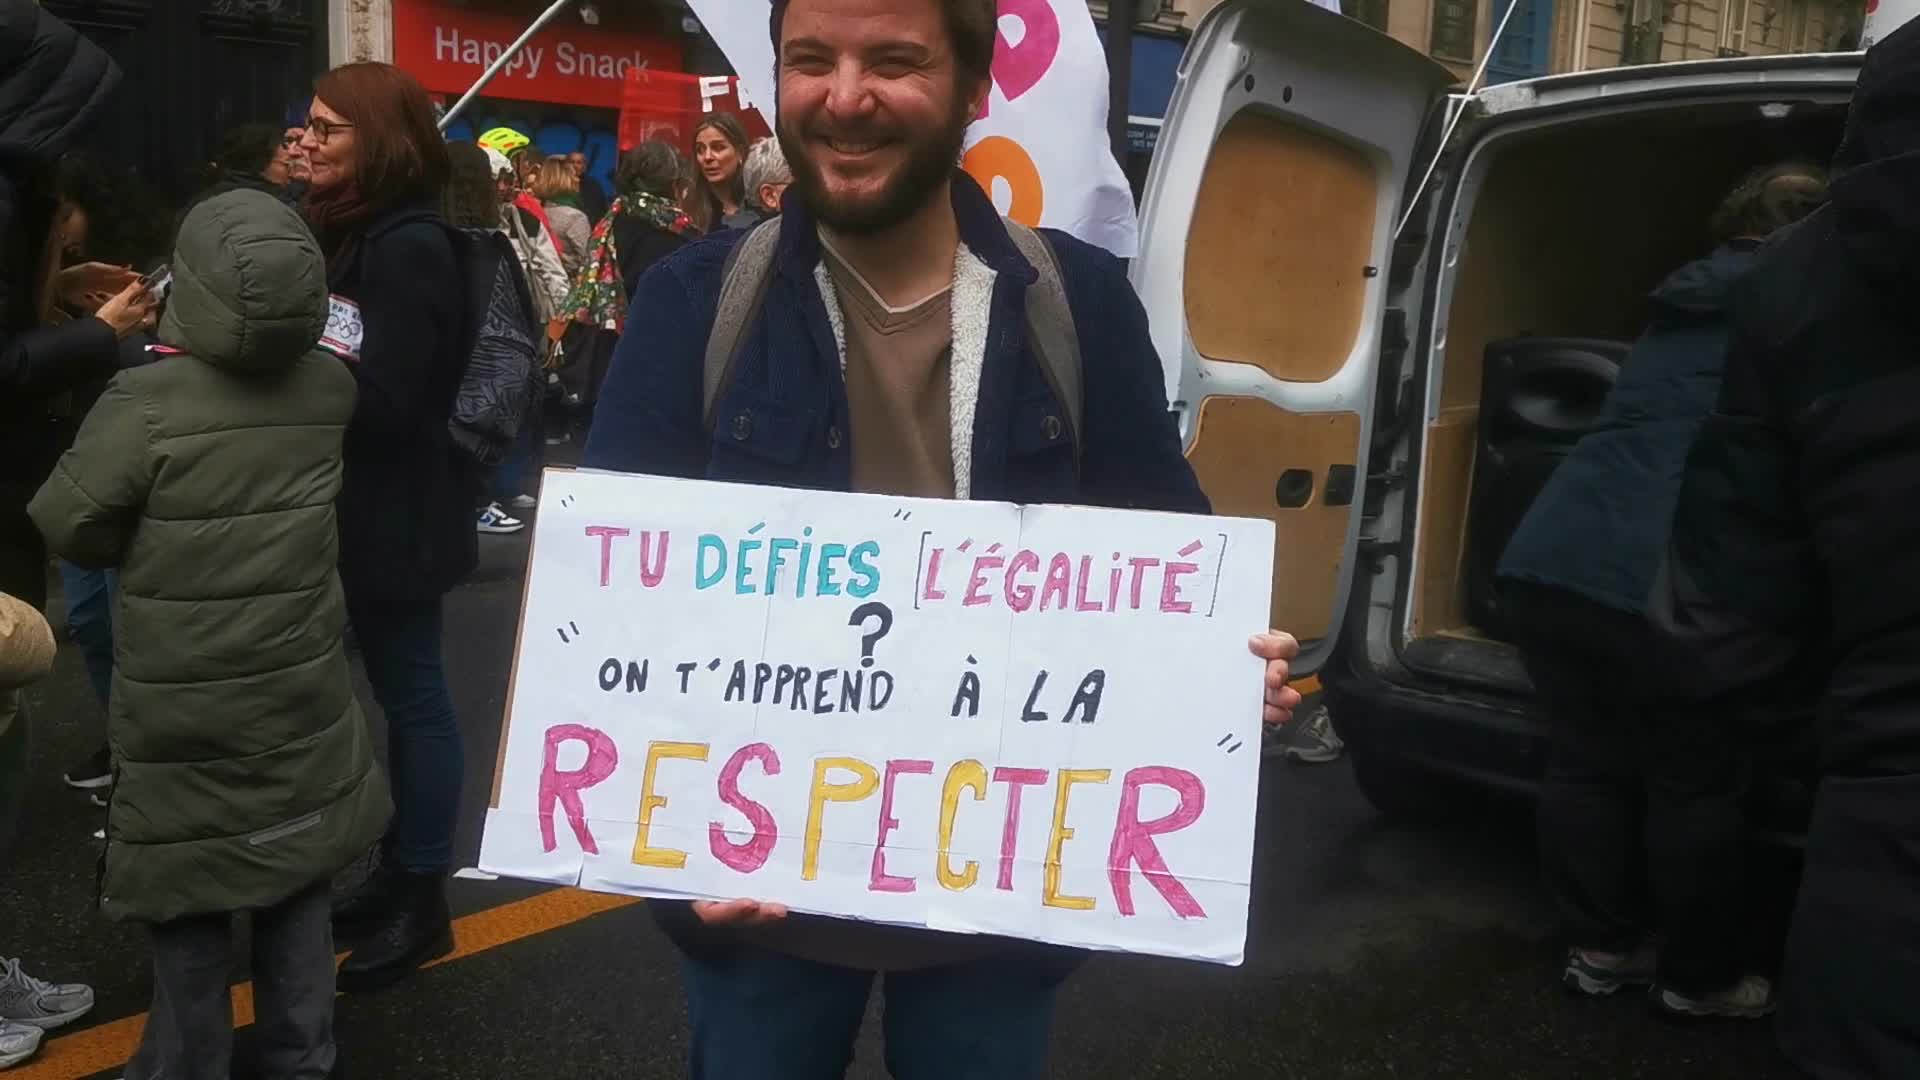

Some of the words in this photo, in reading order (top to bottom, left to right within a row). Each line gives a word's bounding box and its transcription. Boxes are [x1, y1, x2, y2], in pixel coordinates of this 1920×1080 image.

[435, 25, 544, 80] Happy
[554, 41, 649, 82] Snack
[585, 525, 670, 588] TU
[598, 657, 649, 694] ON
[950, 653, 981, 718] À
[1021, 668, 1106, 724] LA
[537, 723, 1208, 919] RESPECTER
